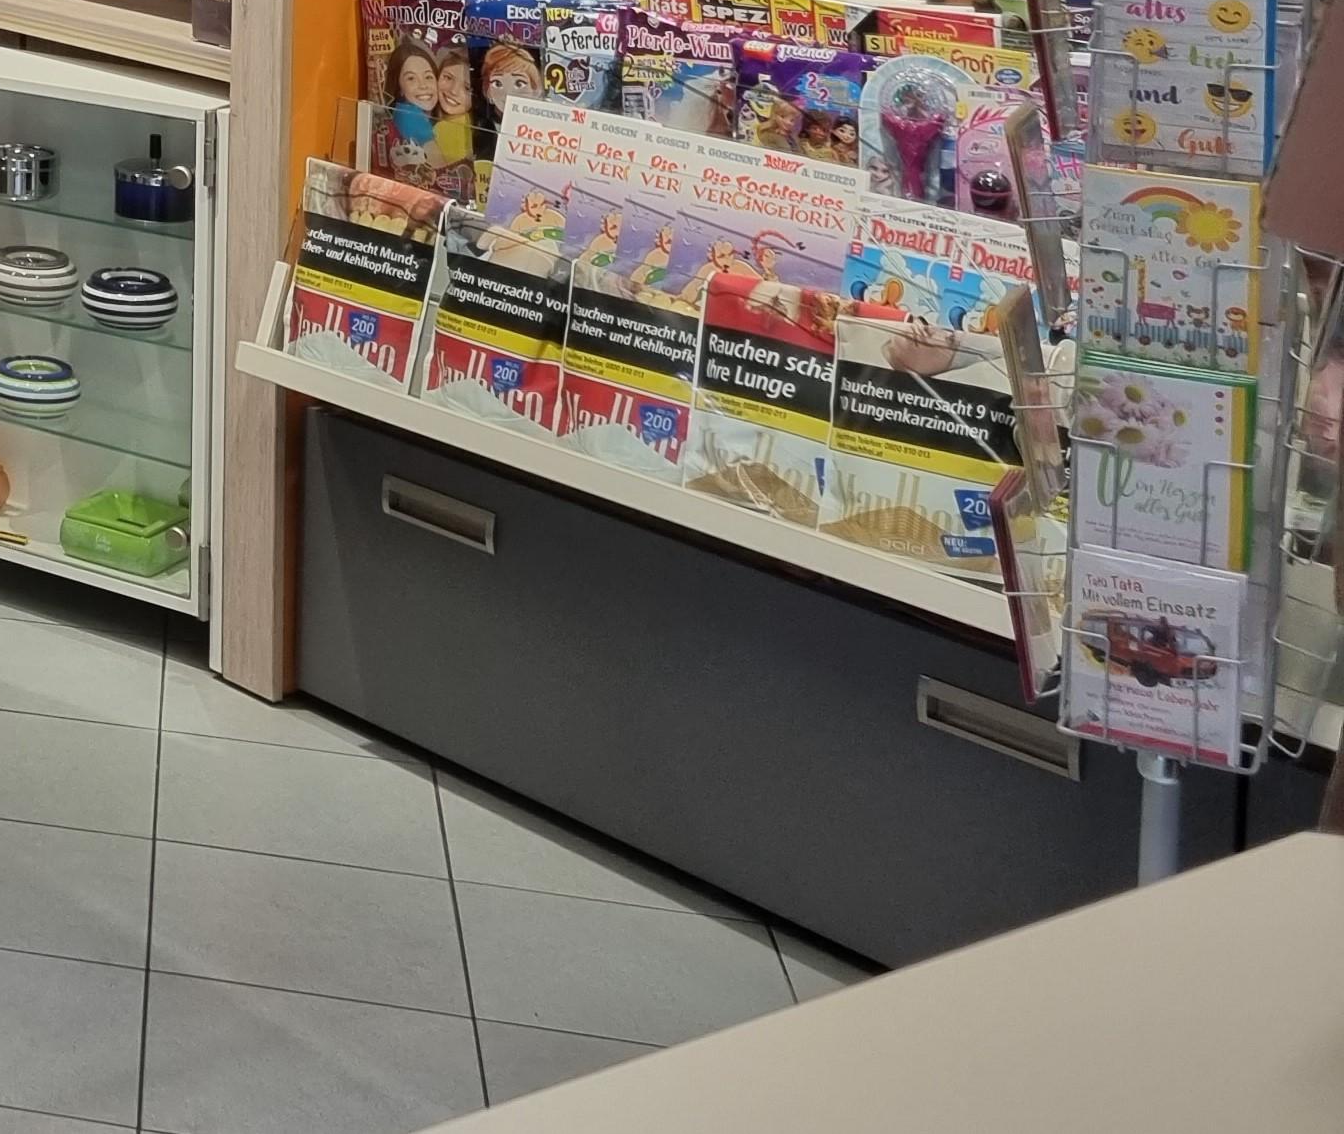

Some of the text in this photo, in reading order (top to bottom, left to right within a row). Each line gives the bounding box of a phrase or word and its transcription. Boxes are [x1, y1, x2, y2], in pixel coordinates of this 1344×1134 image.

[1129, 85, 1182, 105] und
[703, 167, 845, 212] Die Tochter des
[333, 236, 378, 262] verursacht
[871, 219, 938, 256] Donald
[344, 251, 418, 283] Kehlkopfkrebs
[351, 318, 375, 335] 200
[708, 333, 780, 368] Rauchen
[495, 365, 518, 383] 200
[734, 365, 797, 399] Lunge
[850, 395, 989, 441] Lungenkarzinomen
[896, 389, 986, 419] verursacht 9
[1146, 596, 1217, 620] Einsatz
